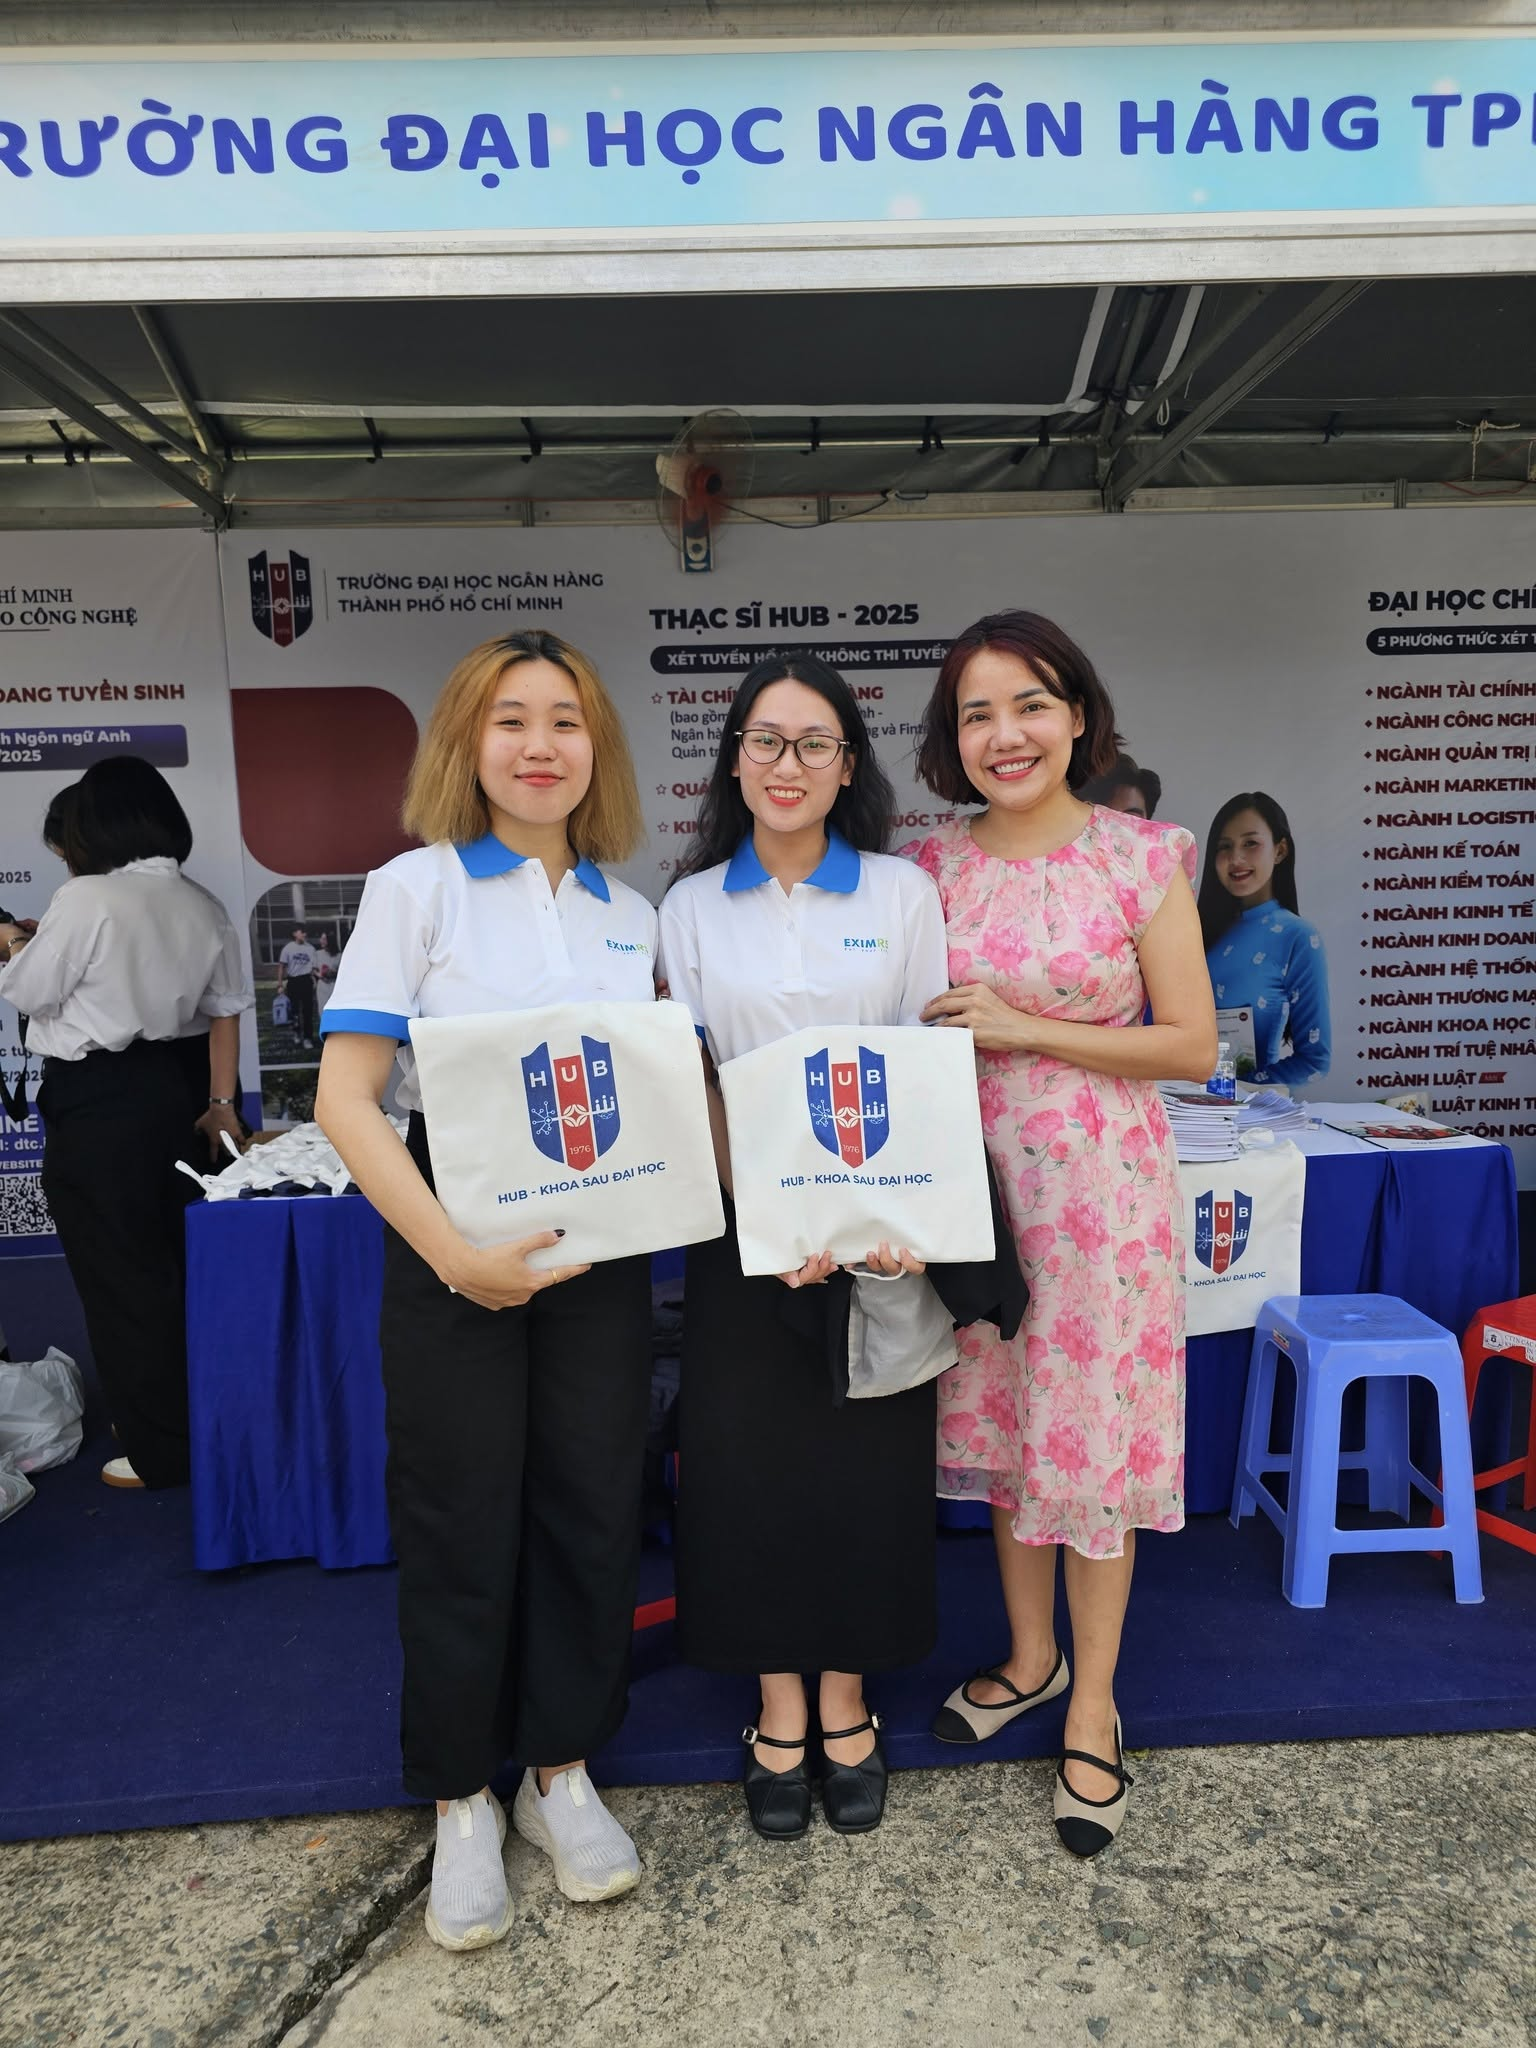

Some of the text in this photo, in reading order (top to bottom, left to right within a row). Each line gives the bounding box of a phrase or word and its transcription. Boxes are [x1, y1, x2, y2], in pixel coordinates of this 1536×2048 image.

[380, 113, 550, 188] ĐẠI
[586, 107, 784, 186] HỌC
[818, 82, 1082, 162] NGÂN
[1119, 79, 1379, 154] HÀNG
[1412, 93, 1536, 149] TP
[337, 571, 604, 592] TRƯỜNG ĐẠI HỌC NGÂN HÀNG
[22, 588, 73, 603] MINH
[338, 594, 563, 612] THÀNH PHỐ HỒ CHÍ MINH
[1368, 590, 1418, 617] ĐẠI
[1426, 589, 1486, 616] HỌC
[20, 607, 76, 625] CÔNG
[82, 607, 138, 627] NGHỆ
[649, 608, 728, 635] THẠC
[736, 602, 761, 628] SĨ
[769, 606, 830, 628] HUB
[854, 604, 919, 626] 2025
[1377, 636, 1386, 648] 5
[1390, 633, 1453, 648] PHƯƠNG
[1456, 631, 1497, 646] THỨC
[1500, 630, 1528, 645] XÉT
[667, 651, 696, 666] XÉT
[700, 648, 750, 665] TUYỂN
[874, 649, 899, 661] THI
[57, 679, 128, 702] TUYỂN
[134, 684, 185, 700] SINH
[667, 687, 697, 704] TÀI
[701, 686, 737, 704] CHÍ
[1376, 682, 1442, 700] NGÀNH
[1446, 680, 1475, 698] TÀI
[670, 710, 699, 726] (bao
[1376, 710, 1536, 730] NGÀNH CÔNG NGH
[15, 731, 58, 747] Ngôn
[62, 730, 94, 746] ngữ
[97, 730, 131, 743] Anh
[671, 728, 704, 743] Ngân
[881, 723, 896, 735] và
[672, 745, 706, 760] Quản
[1375, 741, 1530, 763] NGÀNH QUẢN TRỊ
[1375, 777, 1440, 794] NGÀNH
[1376, 810, 1536, 828] NGÀNH LOGISTI
[1374, 840, 1520, 861] NGÀNH KẾ TOÁN
[1373, 870, 1535, 891] NGÀNH KIỂM TOÁN
[1373, 899, 1536, 922] NGÀNH KINH TẾ
[1371, 932, 1536, 949] NGÀNH KINH DOAN
[1370, 961, 1445, 978] NGÀNH
[1451, 959, 1478, 979] HỆ
[1370, 991, 1433, 1007] NGÀNH
[1436, 988, 1509, 1005] THƯƠNG
[1369, 1017, 1531, 1035] NGÀNH KHOA HỌC
[1368, 1043, 1430, 1060] NGÀNH
[1434, 1041, 1461, 1058] TRÍ
[1464, 1040, 1497, 1060] TUỆ
[529, 1060, 609, 1088] HUB
[810, 1069, 881, 1086] HUB
[1367, 1071, 1430, 1088] NGÀNH
[1433, 1069, 1477, 1089] LUẬT
[1432, 1095, 1476, 1115] LUẬT
[1479, 1097, 1521, 1112] KINH
[569, 1145, 592, 1155] 1976
[498, 1189, 529, 1205] HUB
[540, 1179, 580, 1196] KHOA
[582, 1174, 609, 1188] SAU
[612, 1168, 635, 1182] ĐẠI
[637, 1161, 666, 1176] HỌC
[780, 1176, 805, 1188] HUB
[815, 1173, 851, 1185] KHOA
[853, 1174, 875, 1186] SAU
[878, 1175, 901, 1188] ĐẠI
[904, 1173, 933, 1187] HỌC
[1198, 1207, 1249, 1219] HUB
[1194, 1279, 1216, 1287] KHOA
[1217, 1276, 1232, 1284] SAU
[1233, 1273, 1247, 1282] ĐẠI
[1248, 1271, 1266, 1280] HỌC
